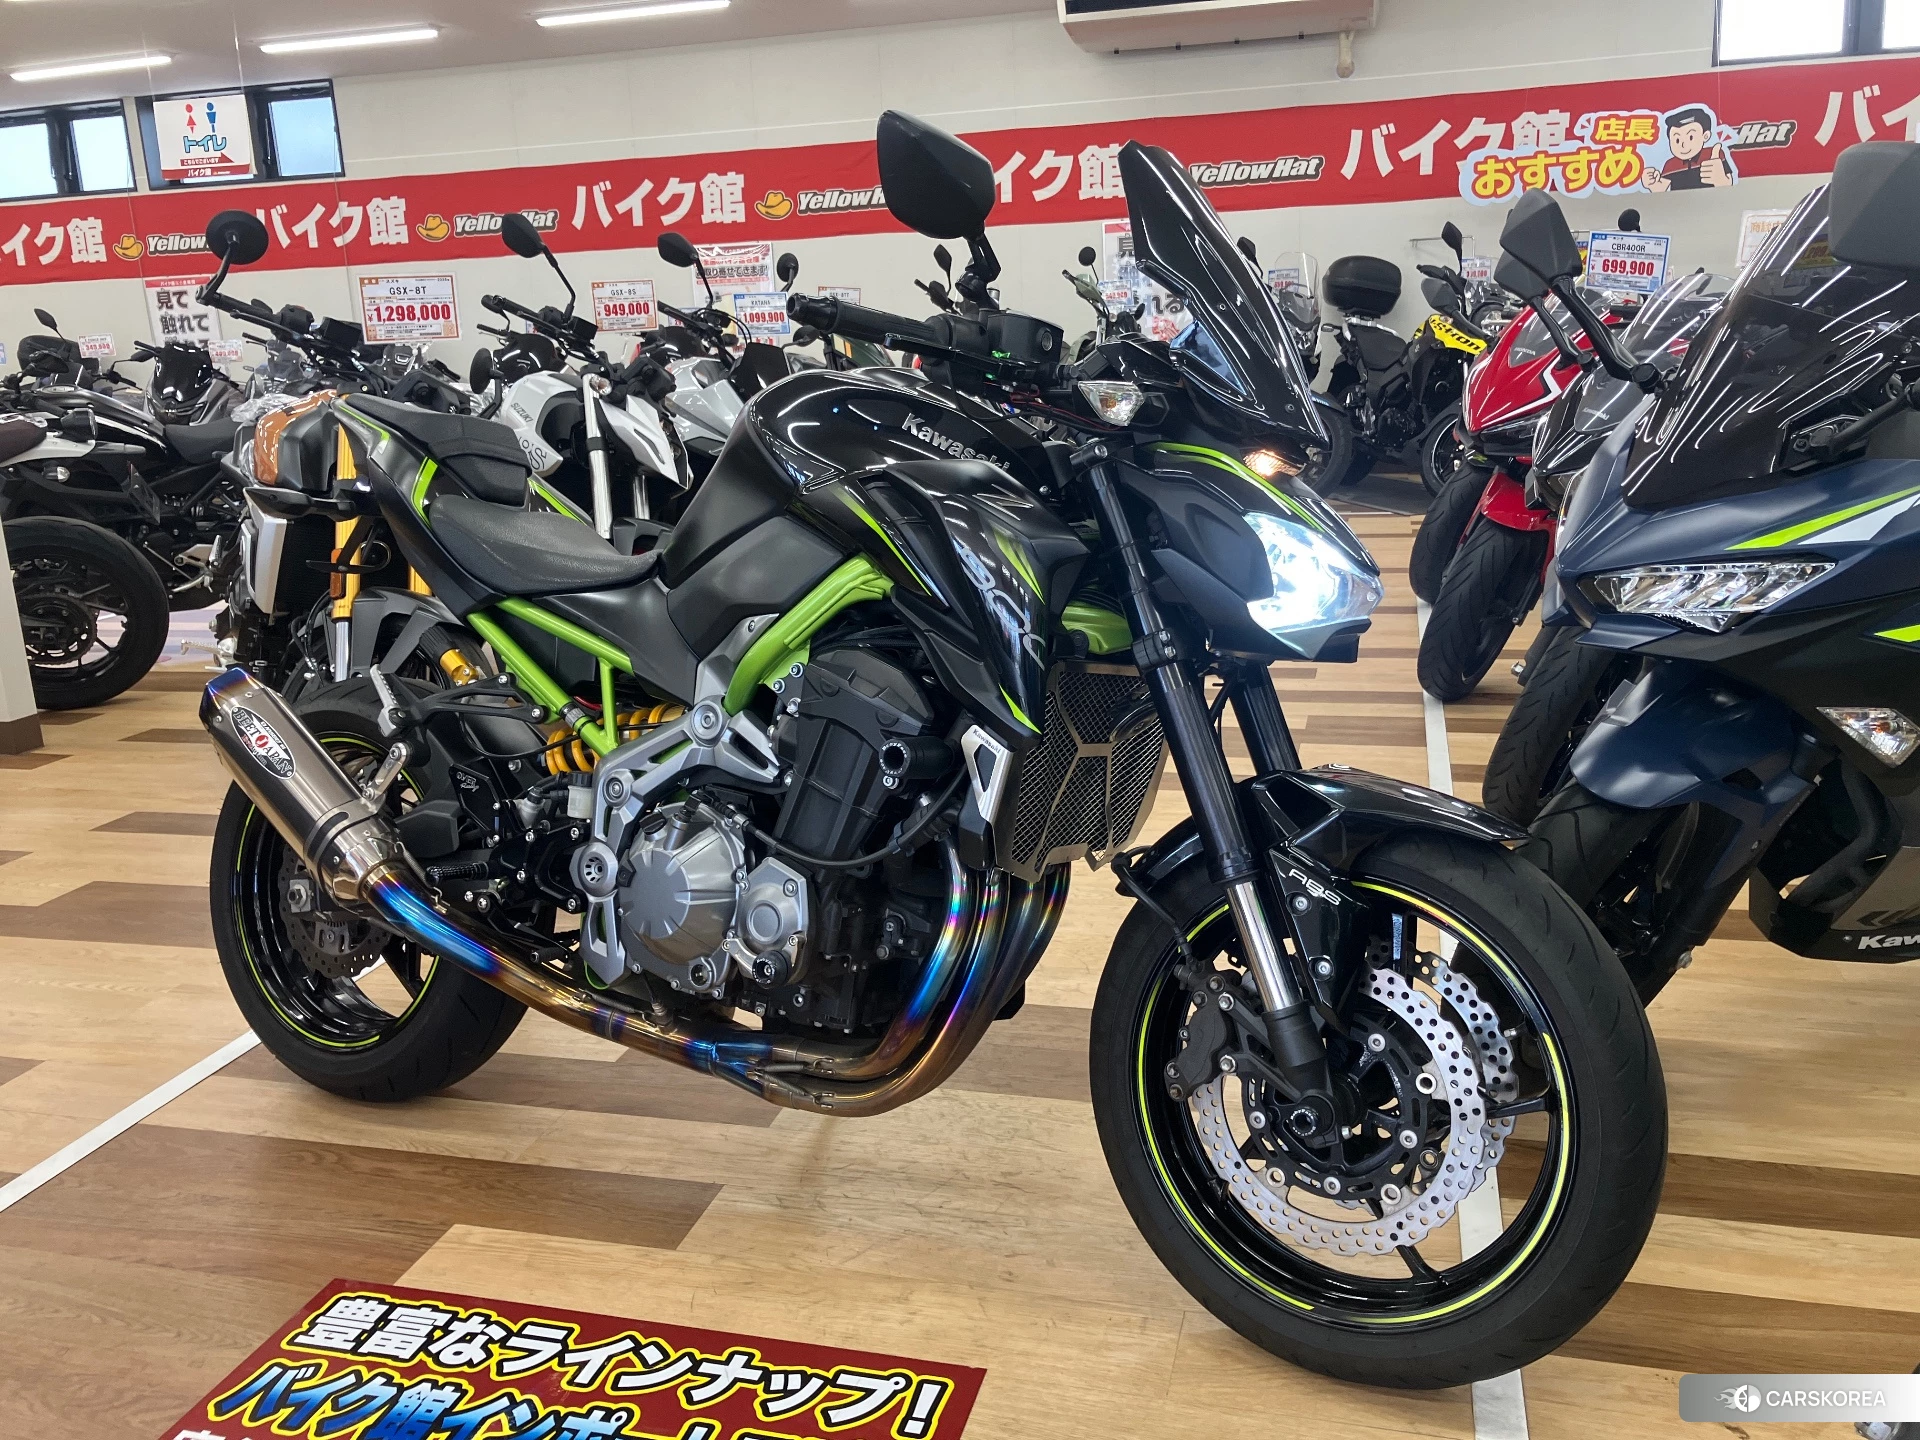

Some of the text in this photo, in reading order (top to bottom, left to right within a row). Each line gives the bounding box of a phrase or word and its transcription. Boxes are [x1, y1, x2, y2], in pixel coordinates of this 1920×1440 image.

[1594, 117, 1655, 141] 店長
[183, 134, 227, 153] トイレ
[994, 144, 1126, 203] イク館
[1464, 145, 1642, 196] おすすめ
[571, 171, 746, 231] バイク館
[255, 197, 409, 249] バイク館
[455, 210, 556, 234] YelloHat
[0, 216, 107, 267] イク館
[1611, 242, 1646, 252] CBR400R
[1602, 258, 1654, 276] 699,900
[157, 290, 188, 310] 見て
[389, 286, 427, 295] GSX-8T
[611, 288, 637, 296] GSX-8S
[374, 304, 451, 324] 1,298,000
[603, 302, 650, 317] 949,000
[743, 311, 785, 324] 1,099,900
[160, 313, 210, 334] 触れて
[510, 402, 533, 423] SUZUKI
[232, 709, 262, 738] BEET
[972, 728, 1001, 754] Kawasaki
[1288, 868, 1342, 906] ABS
